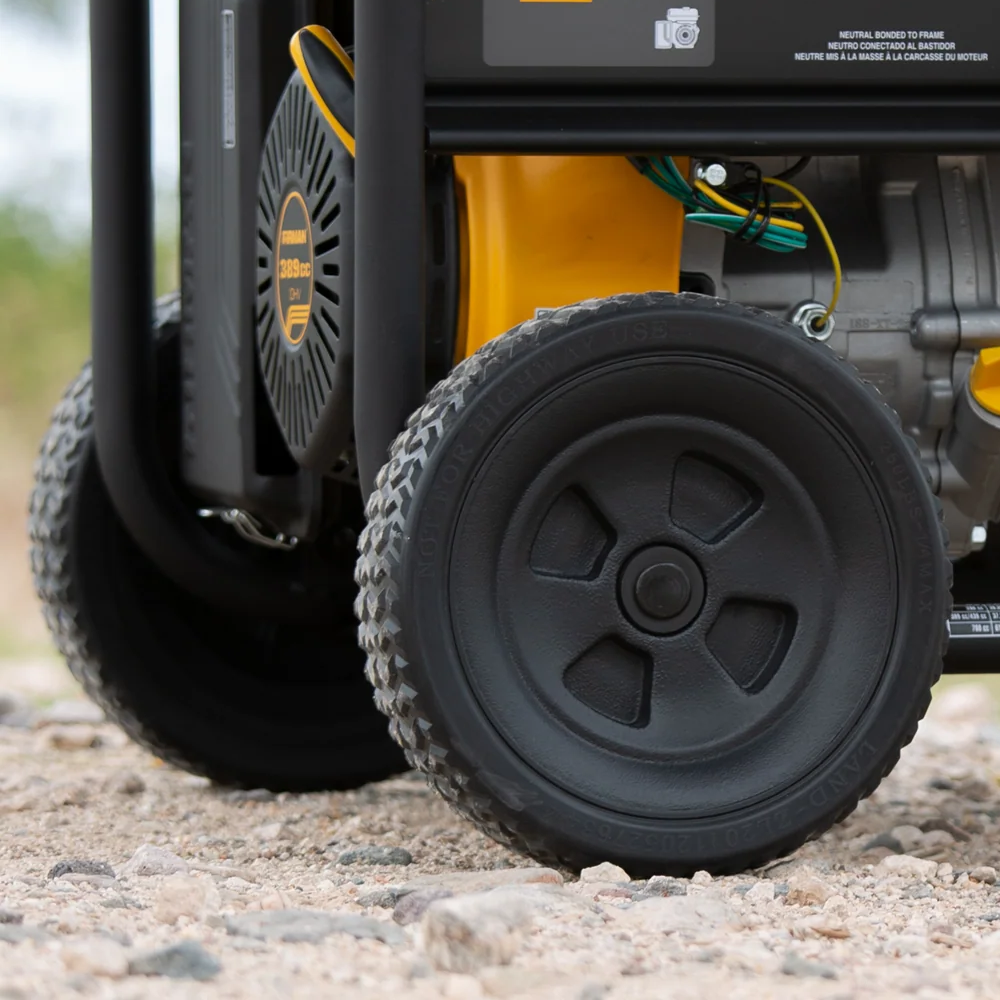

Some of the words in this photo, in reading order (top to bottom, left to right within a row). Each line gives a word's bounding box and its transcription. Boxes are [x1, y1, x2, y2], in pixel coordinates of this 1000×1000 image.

[839, 31, 873, 39] NEUTRAL
[874, 31, 906, 39] BONDED
[907, 31, 918, 39] TO
[919, 31, 945, 39] FRAME
[828, 42, 858, 50] NEUTRO
[859, 42, 906, 50] CONECTADO
[907, 42, 917, 50] AL
[918, 42, 956, 50] BASTIDOR
[794, 52, 825, 61] NEUTRE
[826, 52, 839, 61] MIS
[840, 50, 846, 61] À
[847, 52, 857, 61] LA
[858, 52, 884, 61] MASSE
[885, 50, 893, 61] À
[893, 52, 903, 61] LA
[904, 52, 944, 61] CARCASSE
[945, 53, 956, 61] DU
[957, 53, 989, 61] MOTEUR
[282, 229, 307, 244] FIRMAN
[417, 508, 437, 580] NOT
[437, 443, 474, 508] FOR
[474, 338, 599, 437] HIGHWAY
[609, 321, 668, 345] USE
